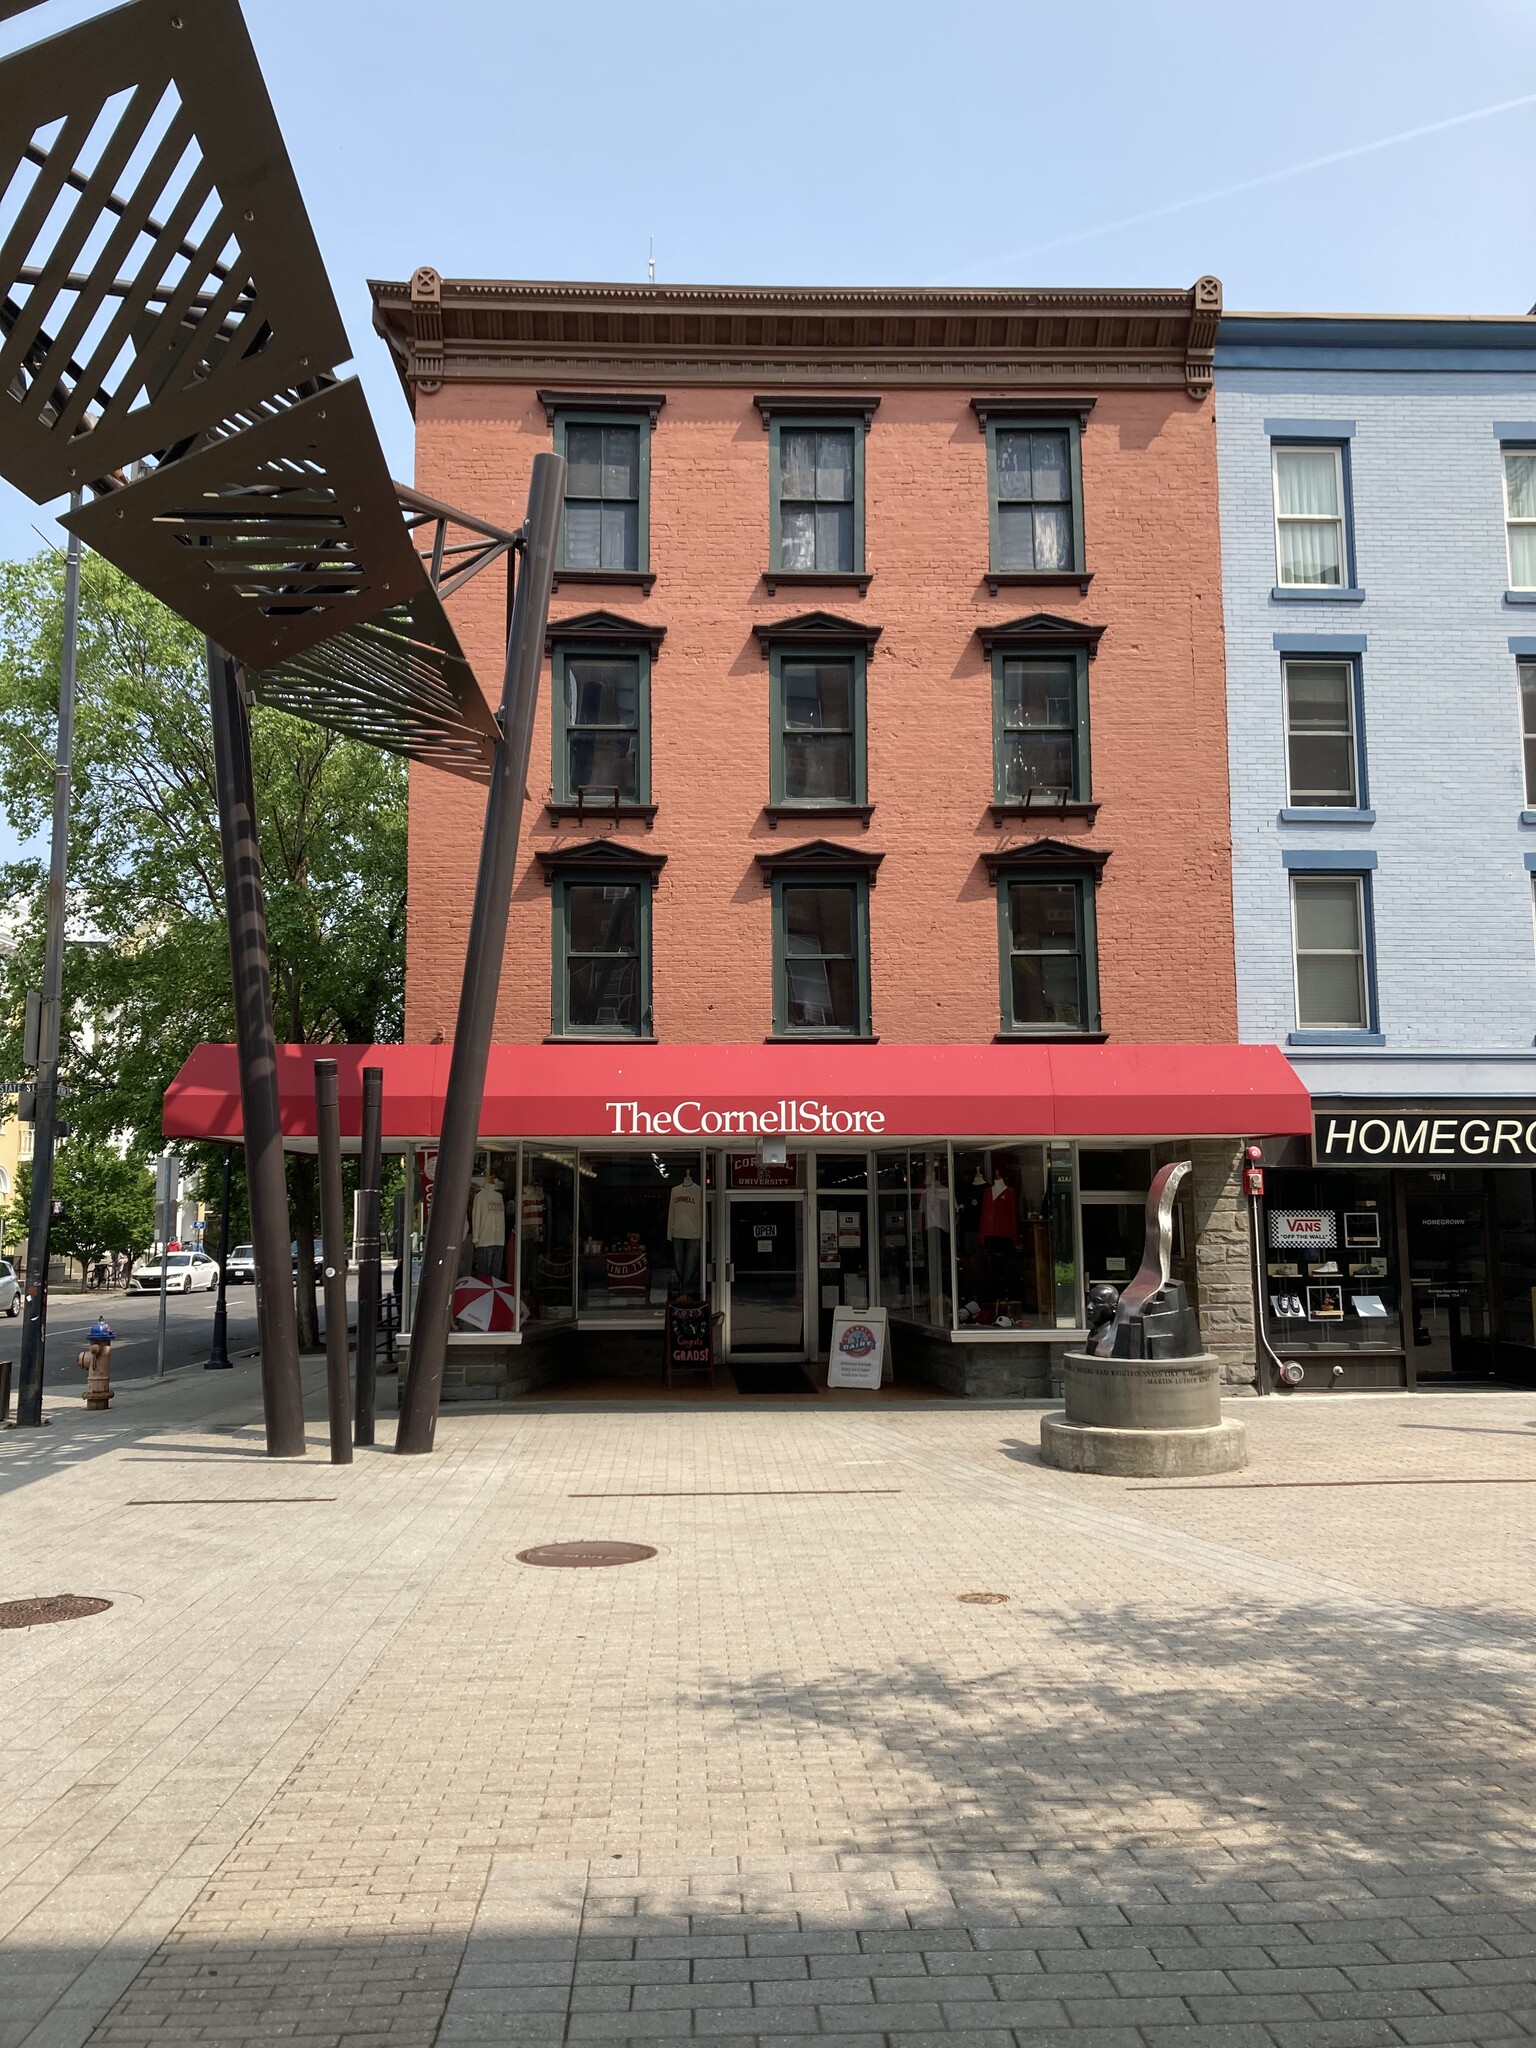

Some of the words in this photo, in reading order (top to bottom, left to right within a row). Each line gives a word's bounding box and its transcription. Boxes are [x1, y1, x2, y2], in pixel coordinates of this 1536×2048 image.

[0, 1084, 21, 1093] STATE
[26, 1084, 35, 1093] ST
[735, 1157, 793, 1170] CORL
[1286, 1218, 1322, 1232] VANS
[755, 1226, 775, 1236] OPEN
[843, 1326, 872, 1341] CORNELL
[843, 1340, 872, 1350] DAIRY
[673, 1348, 709, 1362] GRADS!
[1096, 1368, 1109, 1376] AND
